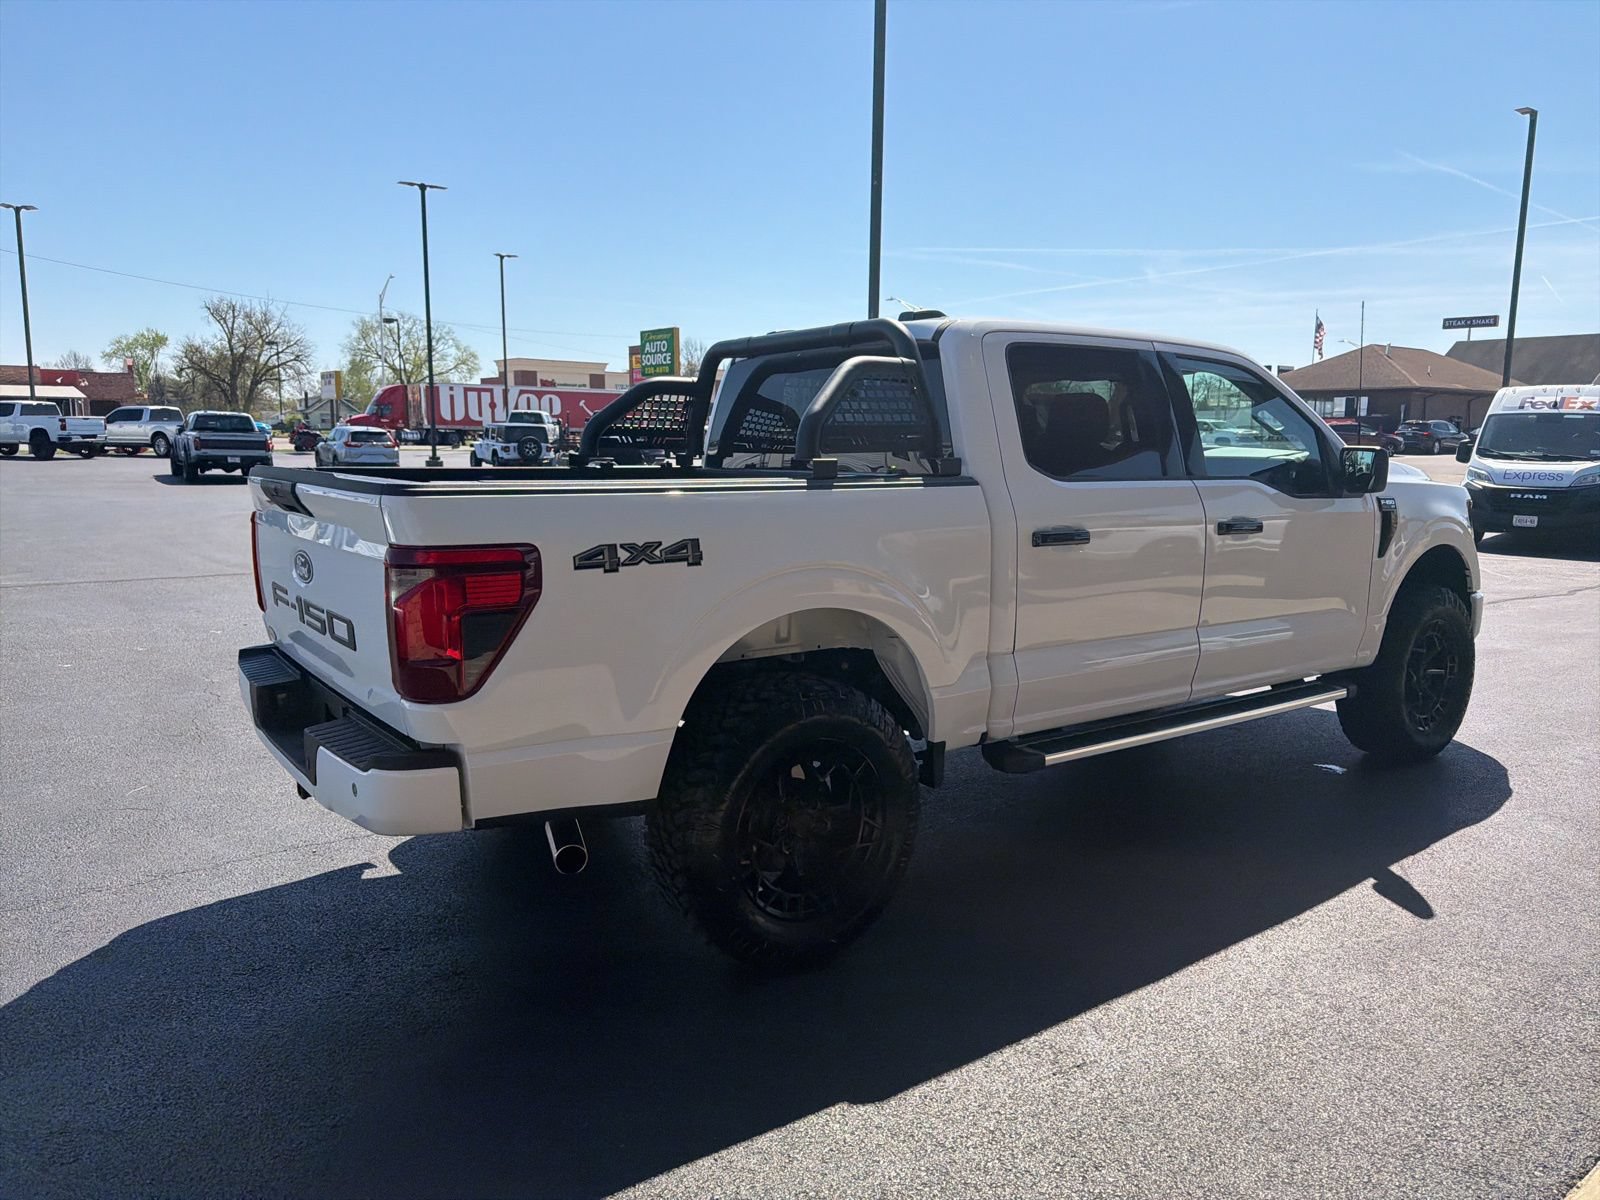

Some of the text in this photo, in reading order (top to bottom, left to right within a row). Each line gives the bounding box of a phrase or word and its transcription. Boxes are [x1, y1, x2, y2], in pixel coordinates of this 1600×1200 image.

[645, 341, 668, 353] AUTO
[642, 353, 672, 366] SOURCE
[1518, 397, 1597, 410] FedEx
[1503, 469, 1564, 483] Express
[271, 581, 357, 652] F-150
